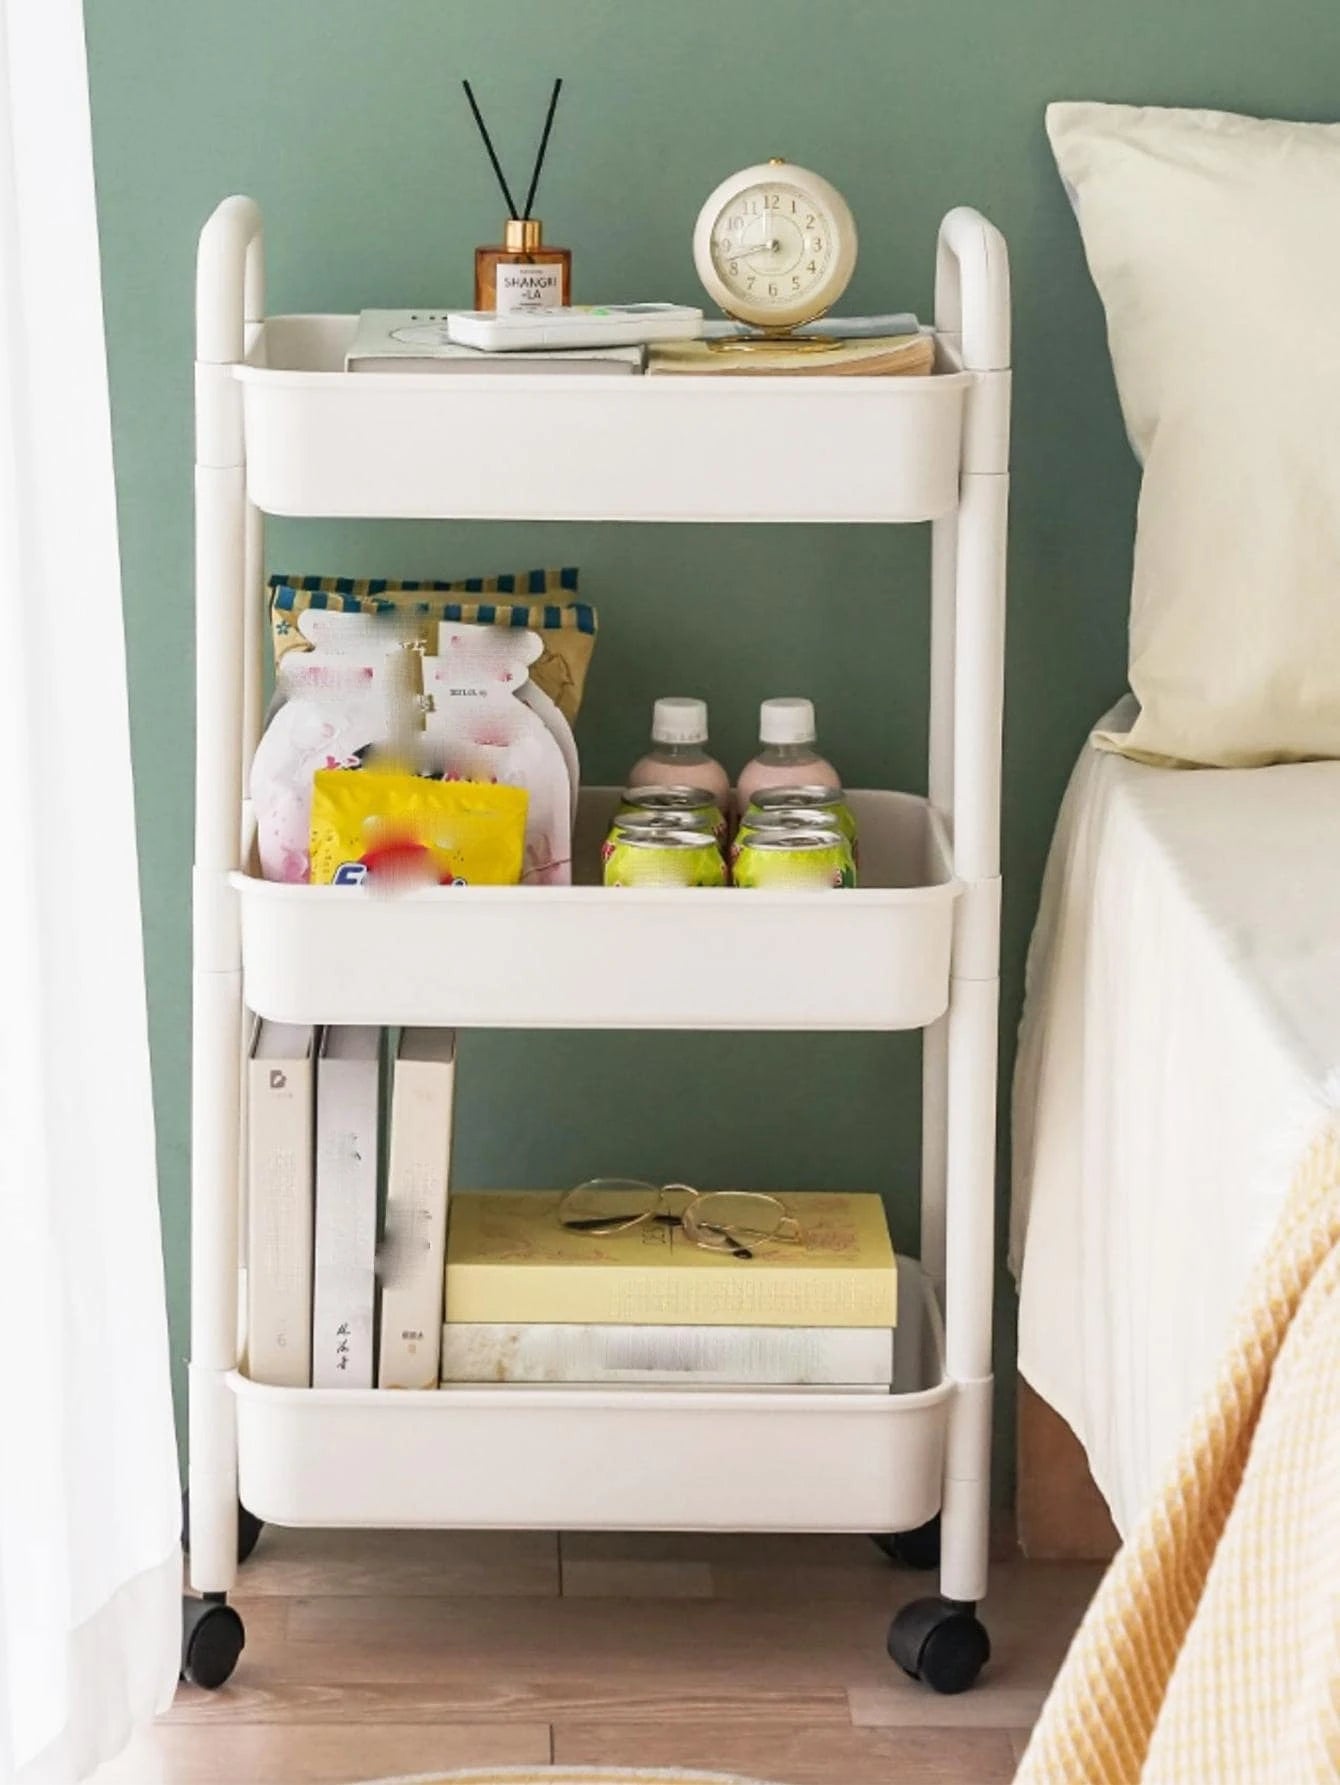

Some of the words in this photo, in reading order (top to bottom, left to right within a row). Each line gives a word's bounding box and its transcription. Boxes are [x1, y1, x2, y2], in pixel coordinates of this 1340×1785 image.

[743, 202, 758, 215] 11
[764, 195, 780, 209] 12
[791, 200, 797, 214] 1
[728, 217, 744, 231] 10
[806, 215, 815, 229] 2
[722, 238, 731, 252] 9
[815, 238, 823, 252] 3
[730, 262, 739, 276] 8
[806, 260, 817, 274] 4
[504, 277, 557, 288] SHANGRI
[747, 277, 757, 290] 7
[768, 283, 778, 296] 6
[791, 276, 801, 291] 5
